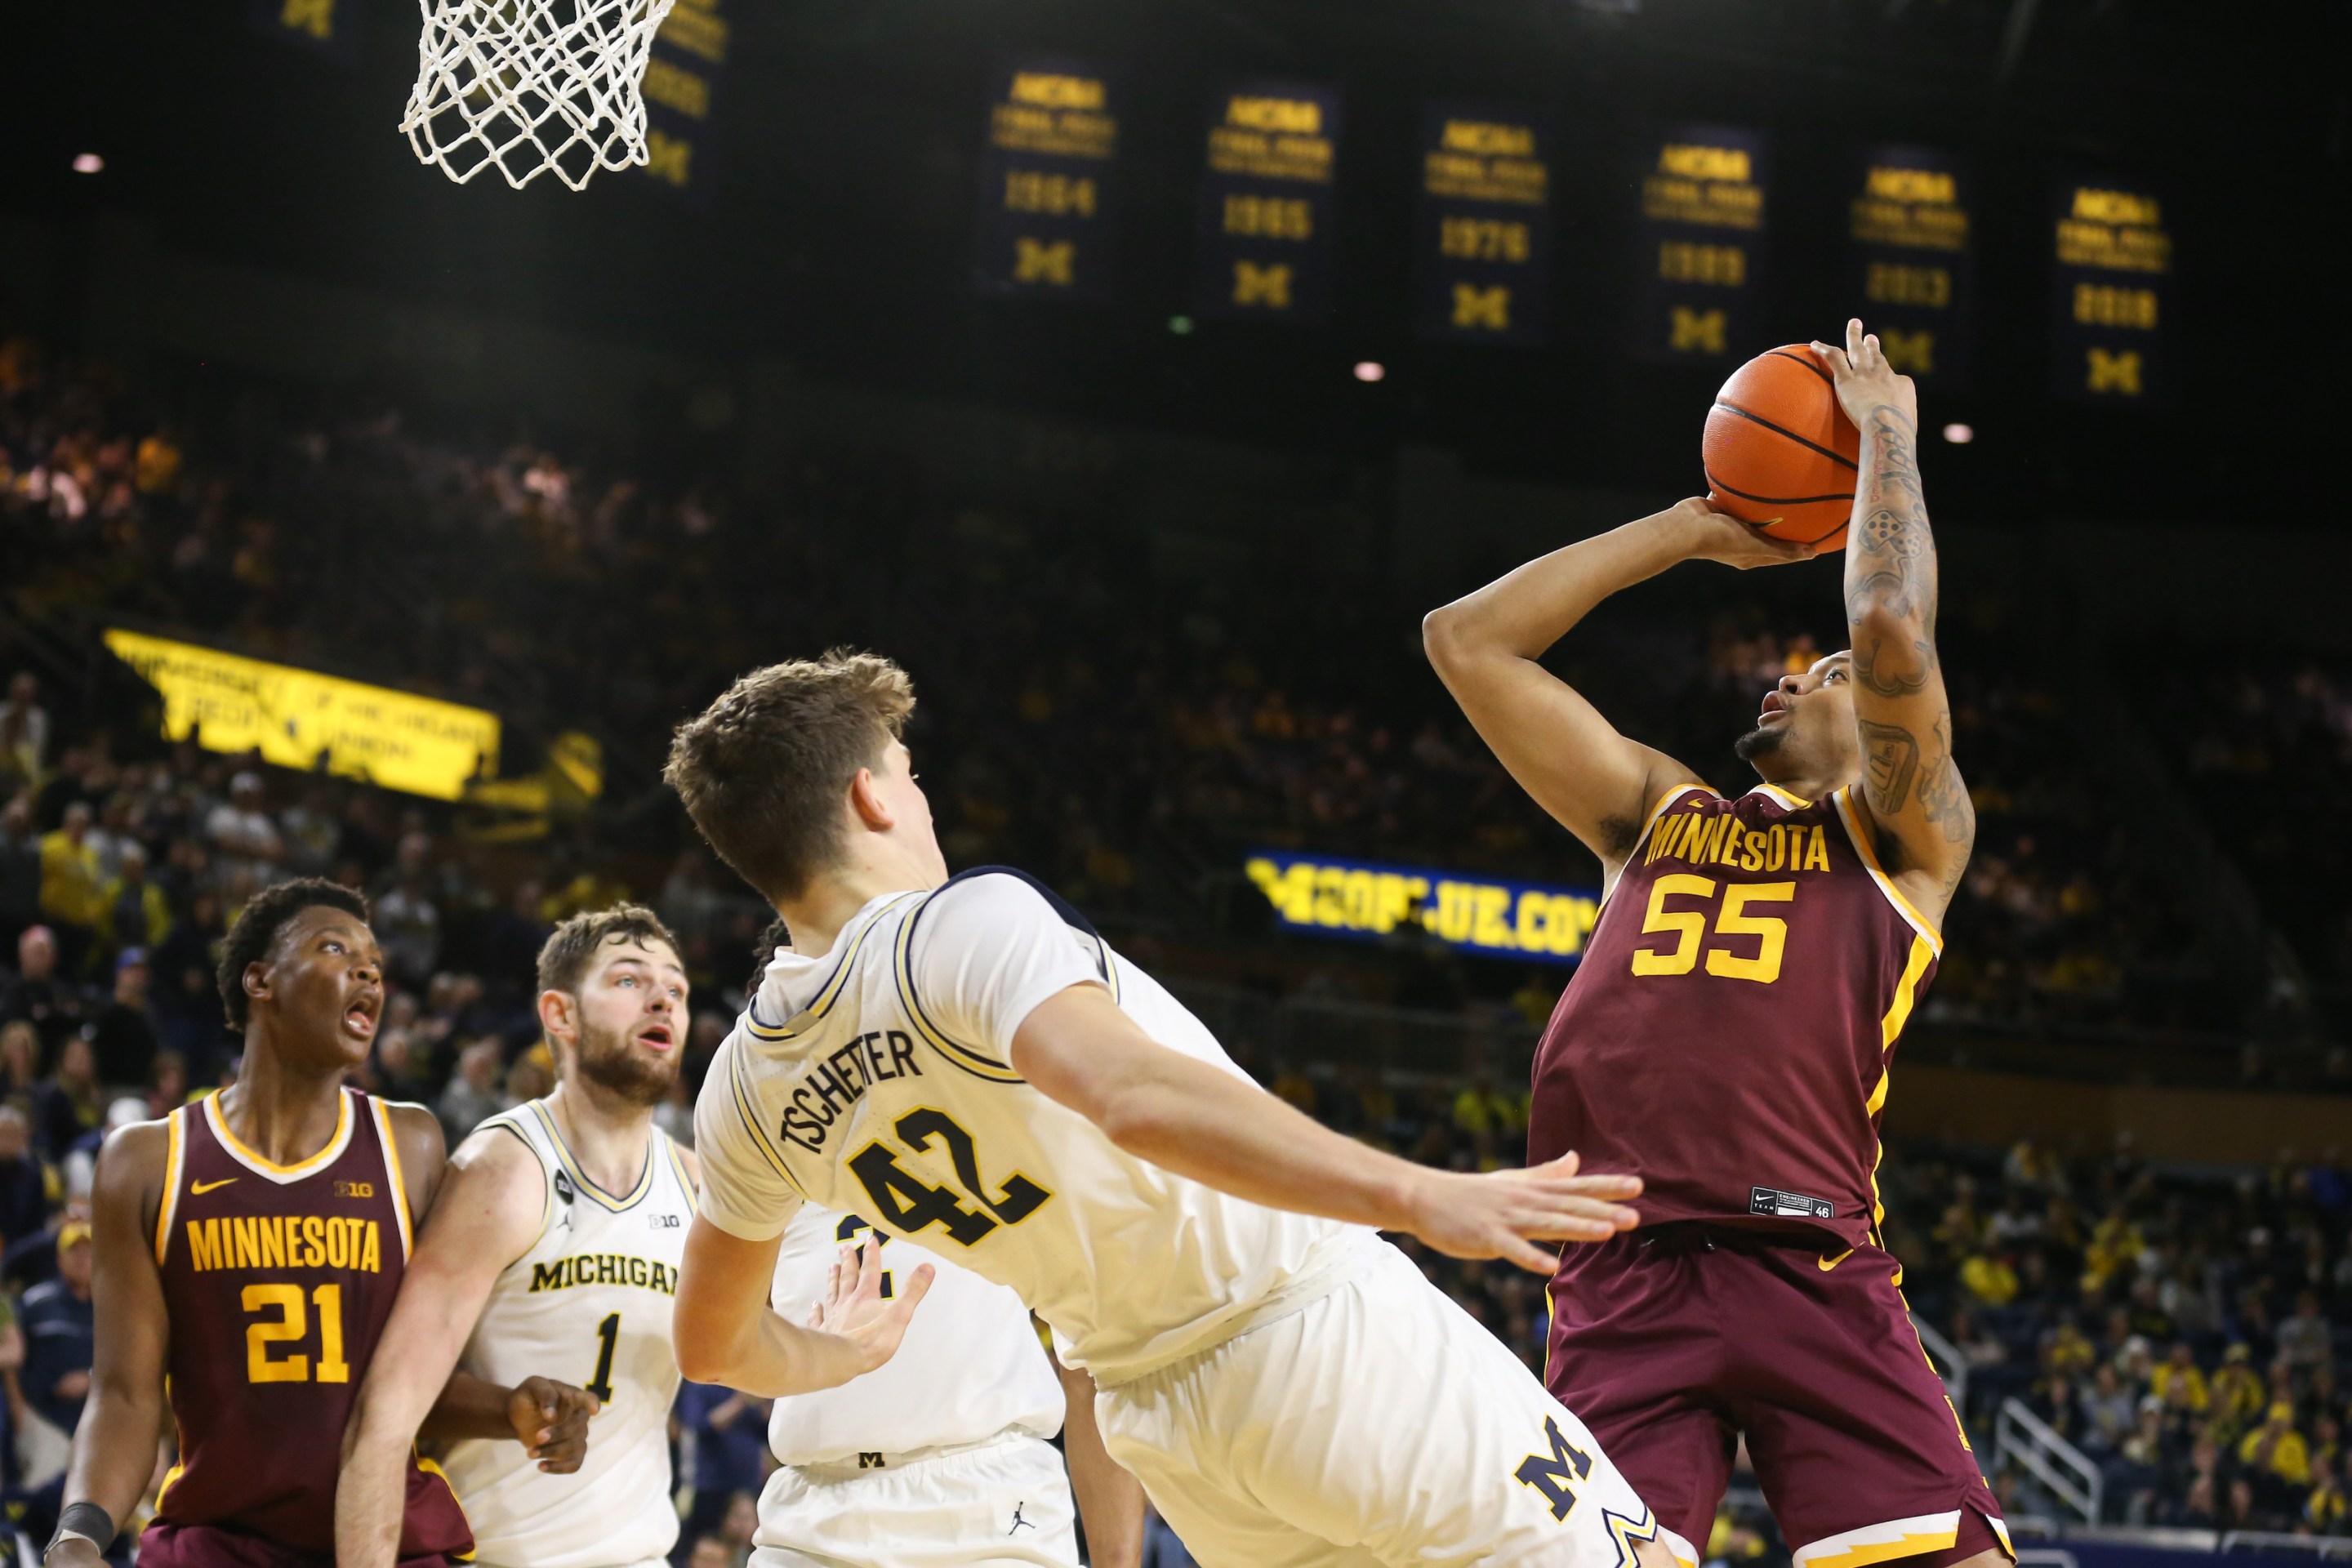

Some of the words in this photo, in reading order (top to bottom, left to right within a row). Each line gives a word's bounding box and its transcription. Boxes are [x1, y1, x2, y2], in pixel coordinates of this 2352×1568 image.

[1644, 813, 1830, 872] MINNESOTA
[1631, 873, 1796, 984] 55
[844, 1104, 1055, 1249] 42
[1815, 1205, 1829, 1218] 46
[186, 1216, 381, 1274] MINNESOTA
[240, 1283, 350, 1384] 21
[584, 1311, 621, 1405] 1
[858, 1451, 885, 1469] M
[1512, 1411, 1595, 1526] M
